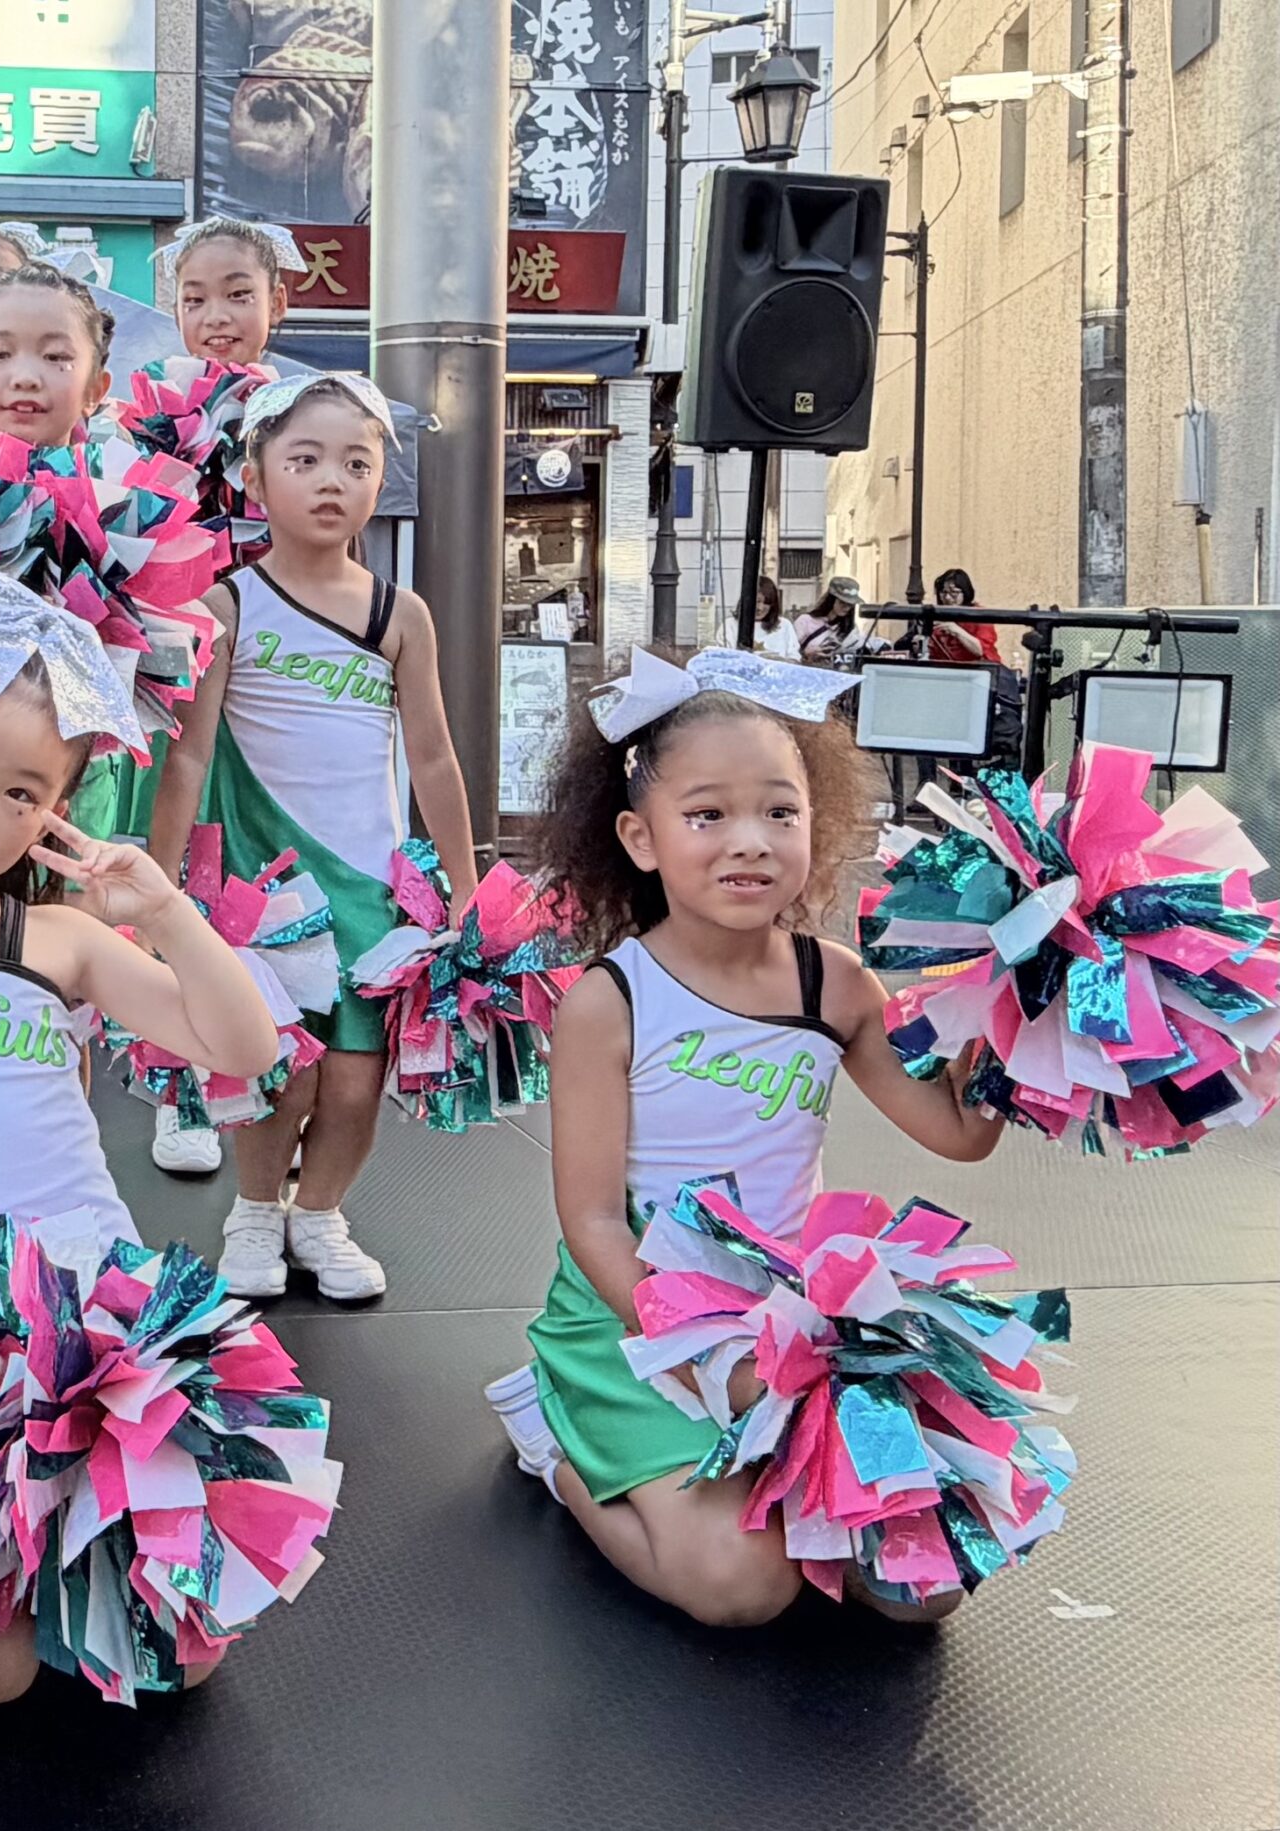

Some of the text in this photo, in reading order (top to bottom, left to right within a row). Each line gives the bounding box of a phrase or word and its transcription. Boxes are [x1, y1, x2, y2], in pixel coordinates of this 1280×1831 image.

[611, 56, 631, 166] アイスもなか
